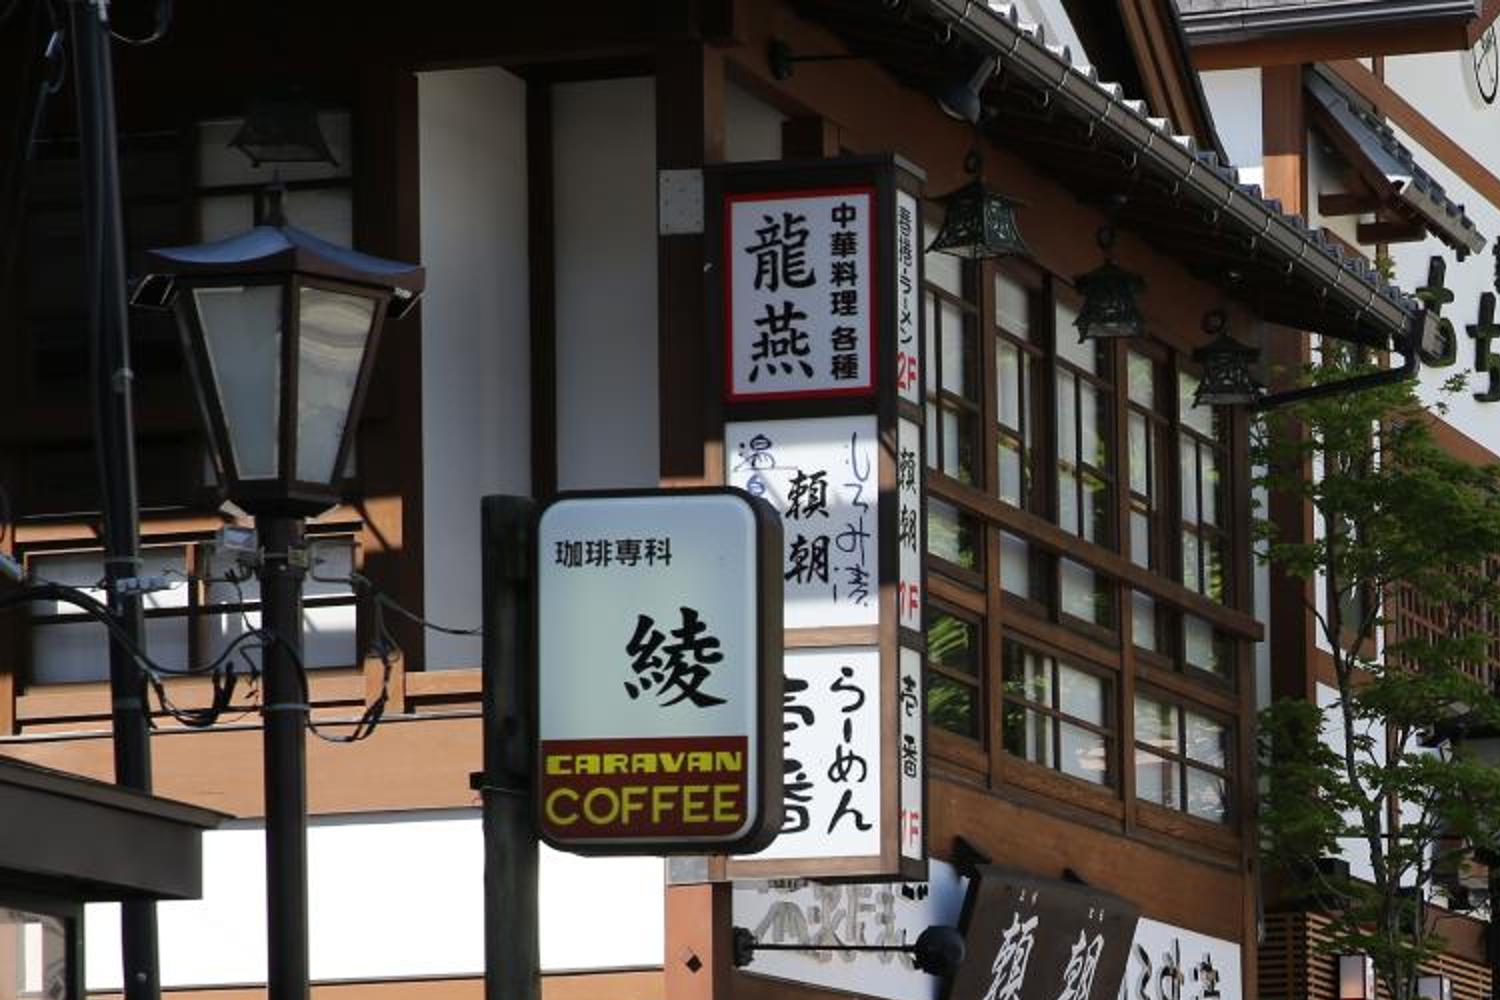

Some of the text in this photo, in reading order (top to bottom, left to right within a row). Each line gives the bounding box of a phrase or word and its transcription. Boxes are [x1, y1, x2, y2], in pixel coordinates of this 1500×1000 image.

[745, 211, 816, 382] 龍燕
[831, 202, 858, 381] 中華料理各種
[555, 537, 672, 567] 珈琲専科
[784, 470, 830, 584] 頼朝
[623, 607, 728, 707] 綾
[545, 751, 742, 776] CARAVAN
[827, 666, 872, 835] らーめん
[544, 783, 741, 826] COFFEE
